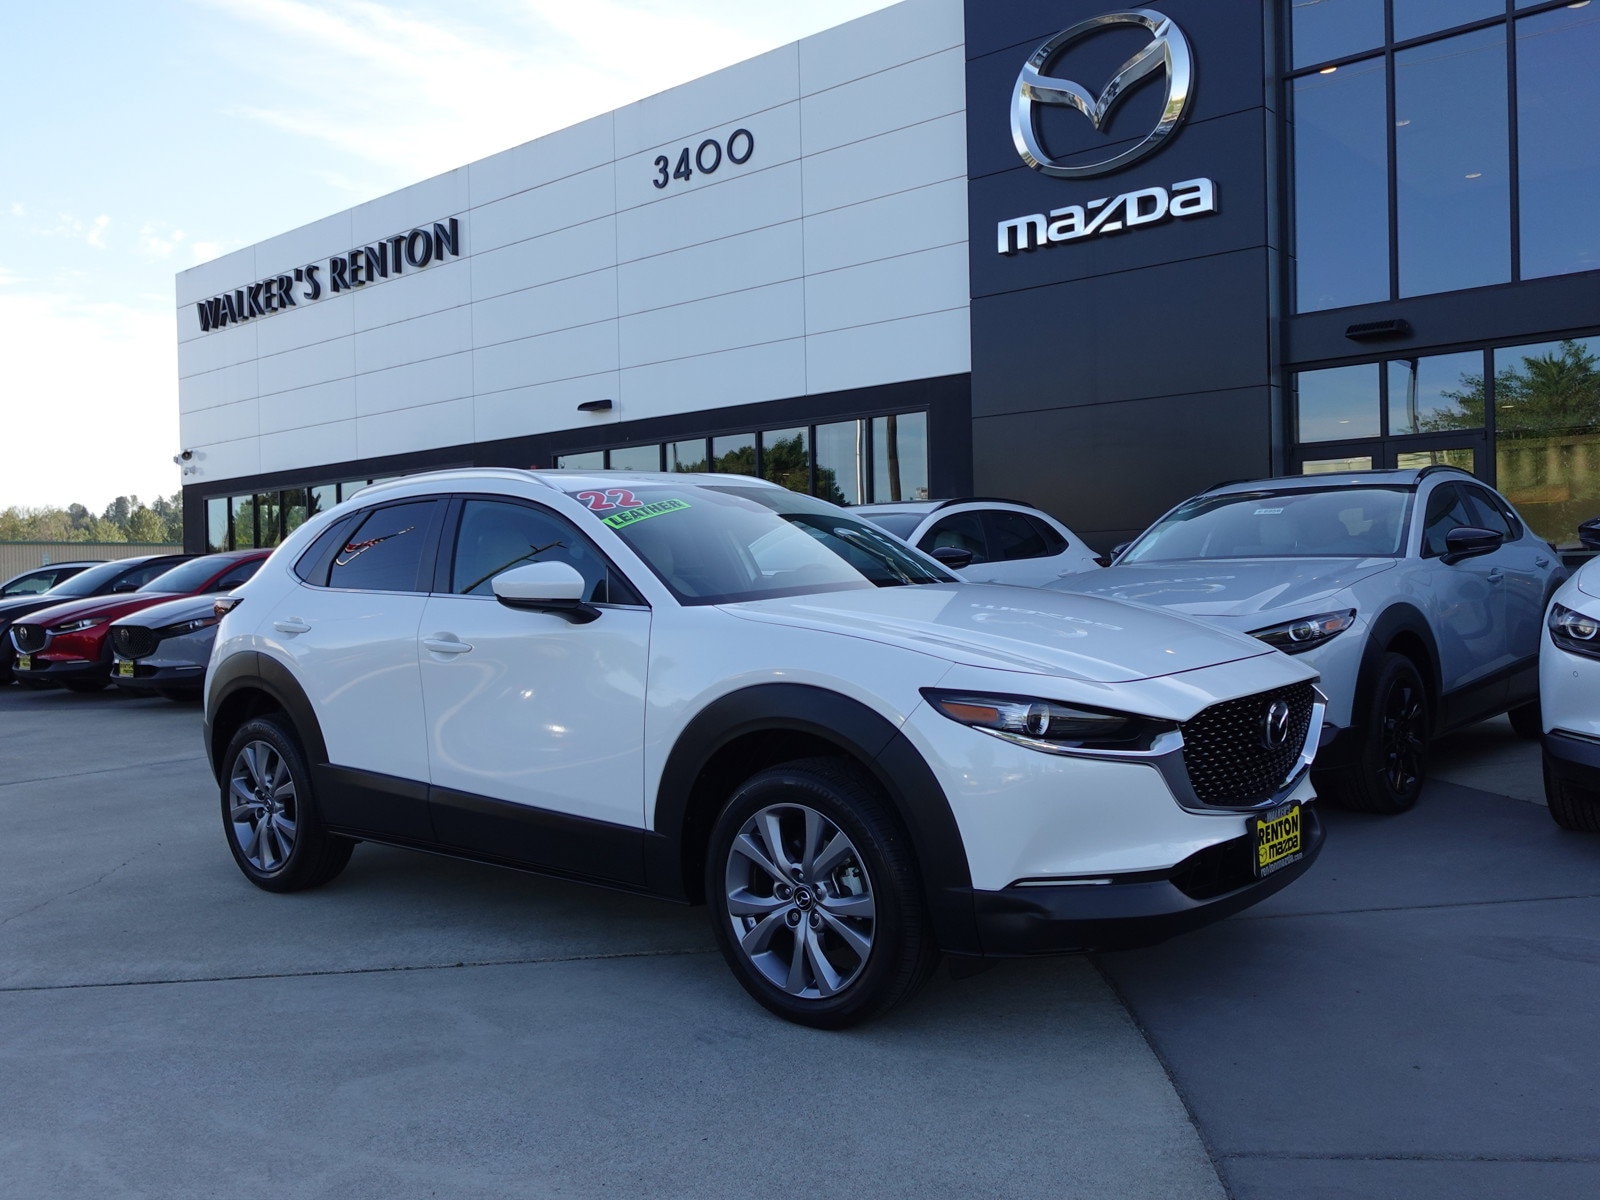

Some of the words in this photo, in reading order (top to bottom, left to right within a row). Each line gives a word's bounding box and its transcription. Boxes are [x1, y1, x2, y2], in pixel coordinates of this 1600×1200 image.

[652, 128, 754, 189] 3400
[196, 264, 320, 332] WALKER'S
[329, 217, 460, 293] RENTON
[576, 488, 645, 511] 22
[607, 499, 683, 526] LEATHER
[1258, 814, 1299, 847] RENTON
